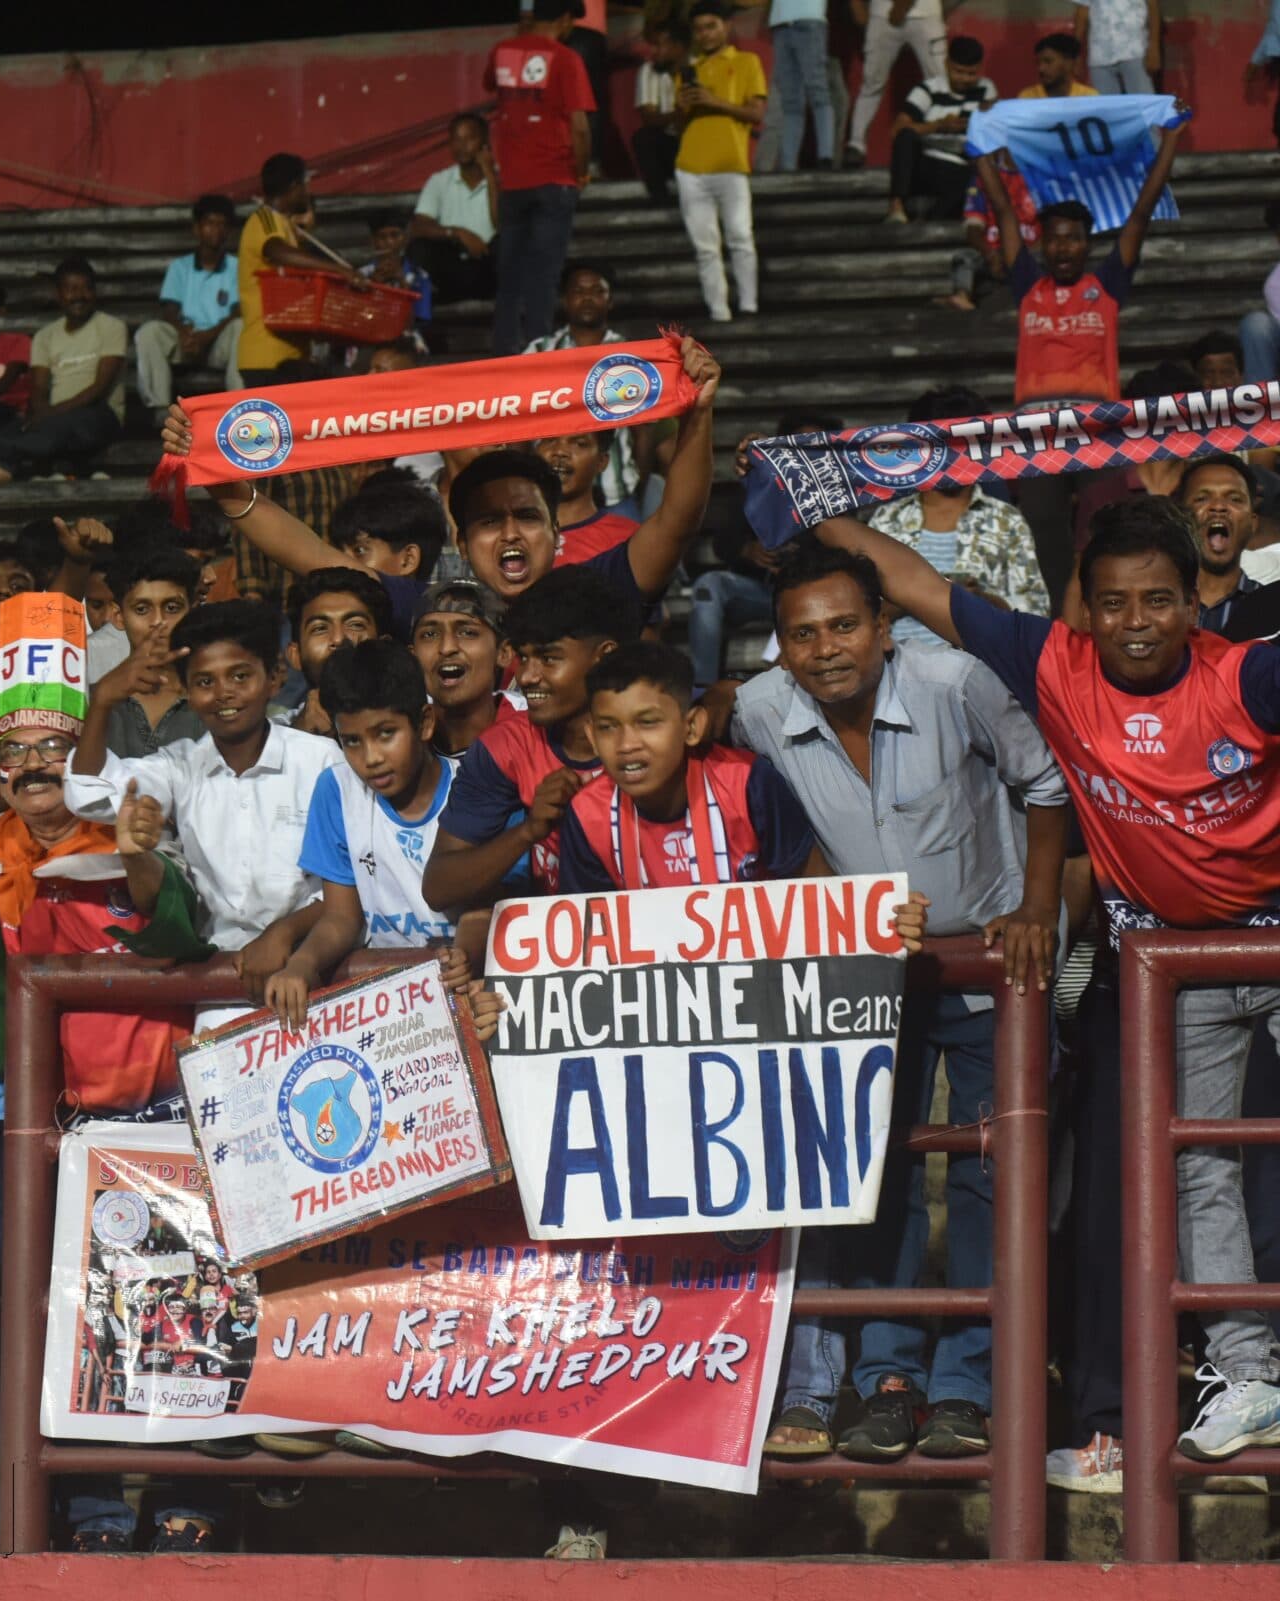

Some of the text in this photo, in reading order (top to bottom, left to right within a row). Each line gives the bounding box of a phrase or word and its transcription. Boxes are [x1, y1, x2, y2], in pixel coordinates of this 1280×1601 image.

[1050, 116, 1115, 160] 10
[303, 386, 573, 441] JAMSHEDPUR FC
[950, 408, 1091, 460] TATA
[1, 644, 81, 684] JFC
[1122, 739, 1166, 754] TATA
[665, 858, 690, 873] TAT
[493, 880, 908, 973] GOAL SAVING
[396, 977, 435, 1015] JFC
[494, 963, 758, 1051] MACHINE
[413, 1109, 472, 1150] FURNACE
[339, 1162, 355, 1171] FC
[290, 1176, 348, 1222] THE
[350, 1160, 396, 1200] RED
[387, 1237, 426, 1271] SE
[443, 1243, 540, 1276] BADA
[671, 1255, 759, 1293] NAHI
[272, 1295, 663, 1360] JAM KE KHELO
[386, 1331, 749, 1401] JAMSHEDPUR
[128, 1390, 226, 1409] JASHEDPUR
[453, 1406, 549, 1429] RELIANCE
